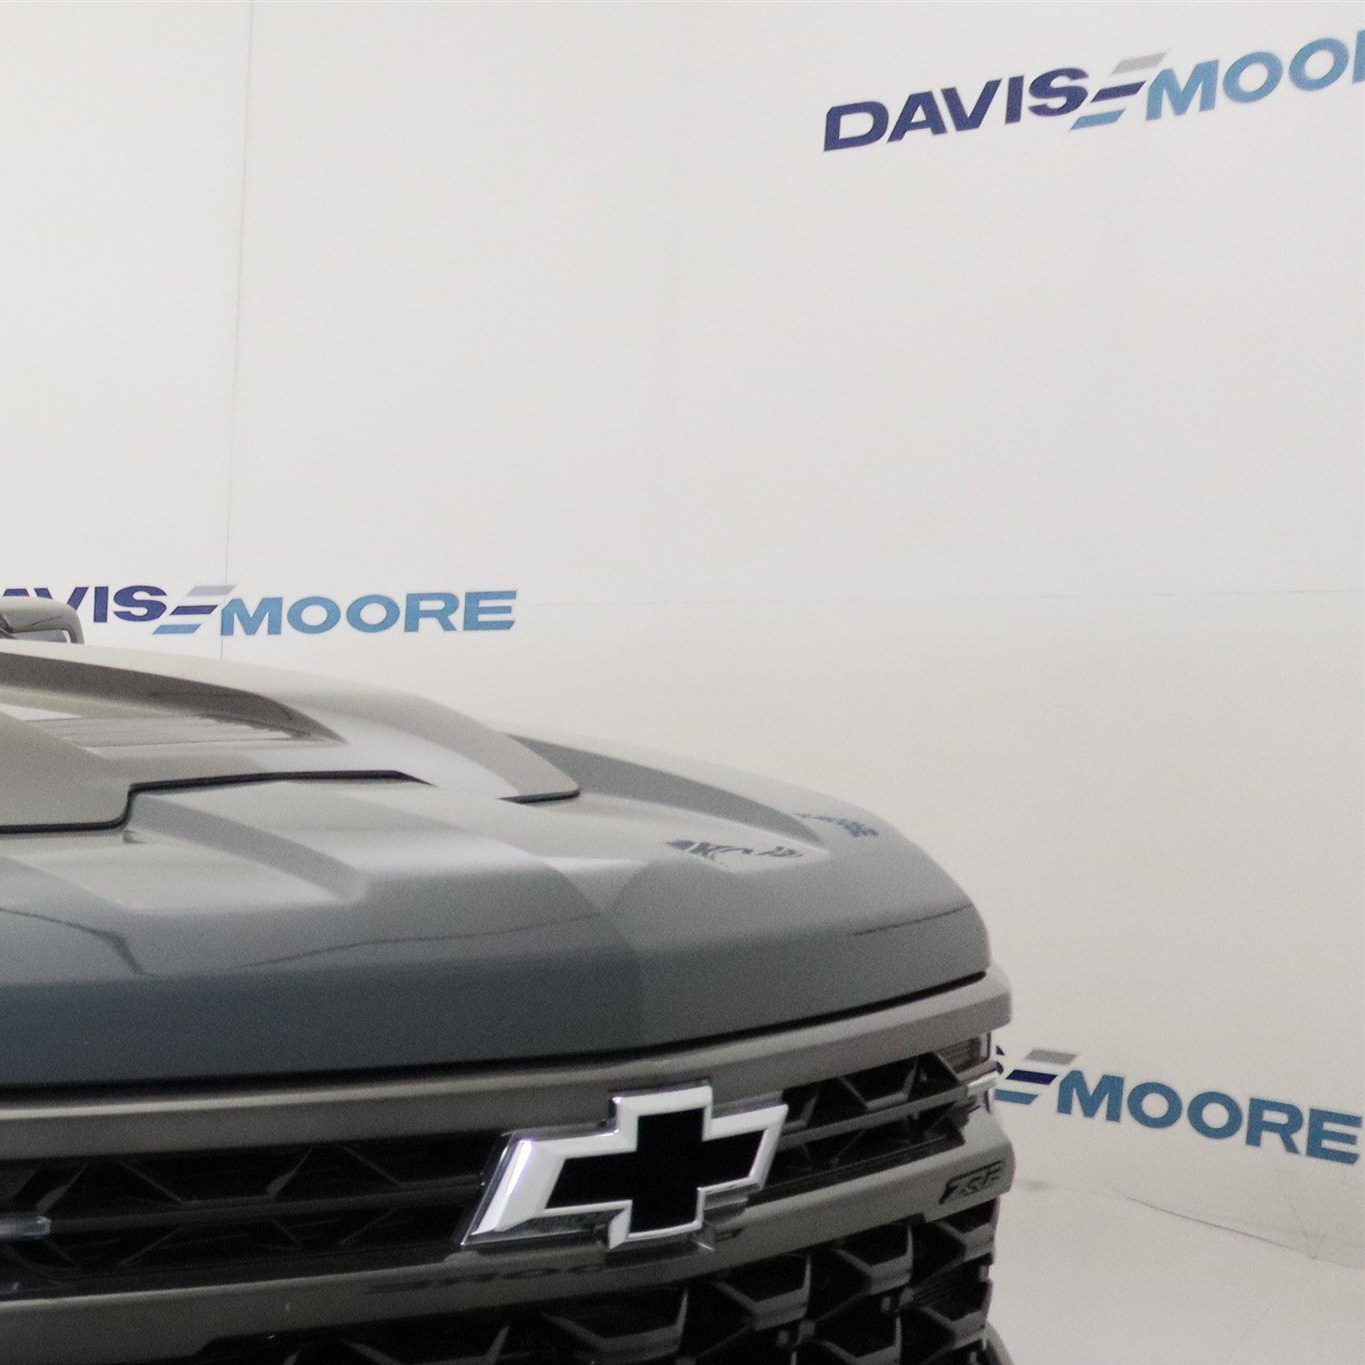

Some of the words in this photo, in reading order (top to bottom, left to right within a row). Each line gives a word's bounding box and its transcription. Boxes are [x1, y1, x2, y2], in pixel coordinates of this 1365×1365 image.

[823, 67, 1089, 152] DAVIS
[1146, 29, 1365, 121] MOO
[220, 590, 517, 637] MOORE
[1057, 1069, 1362, 1165] MOORE
